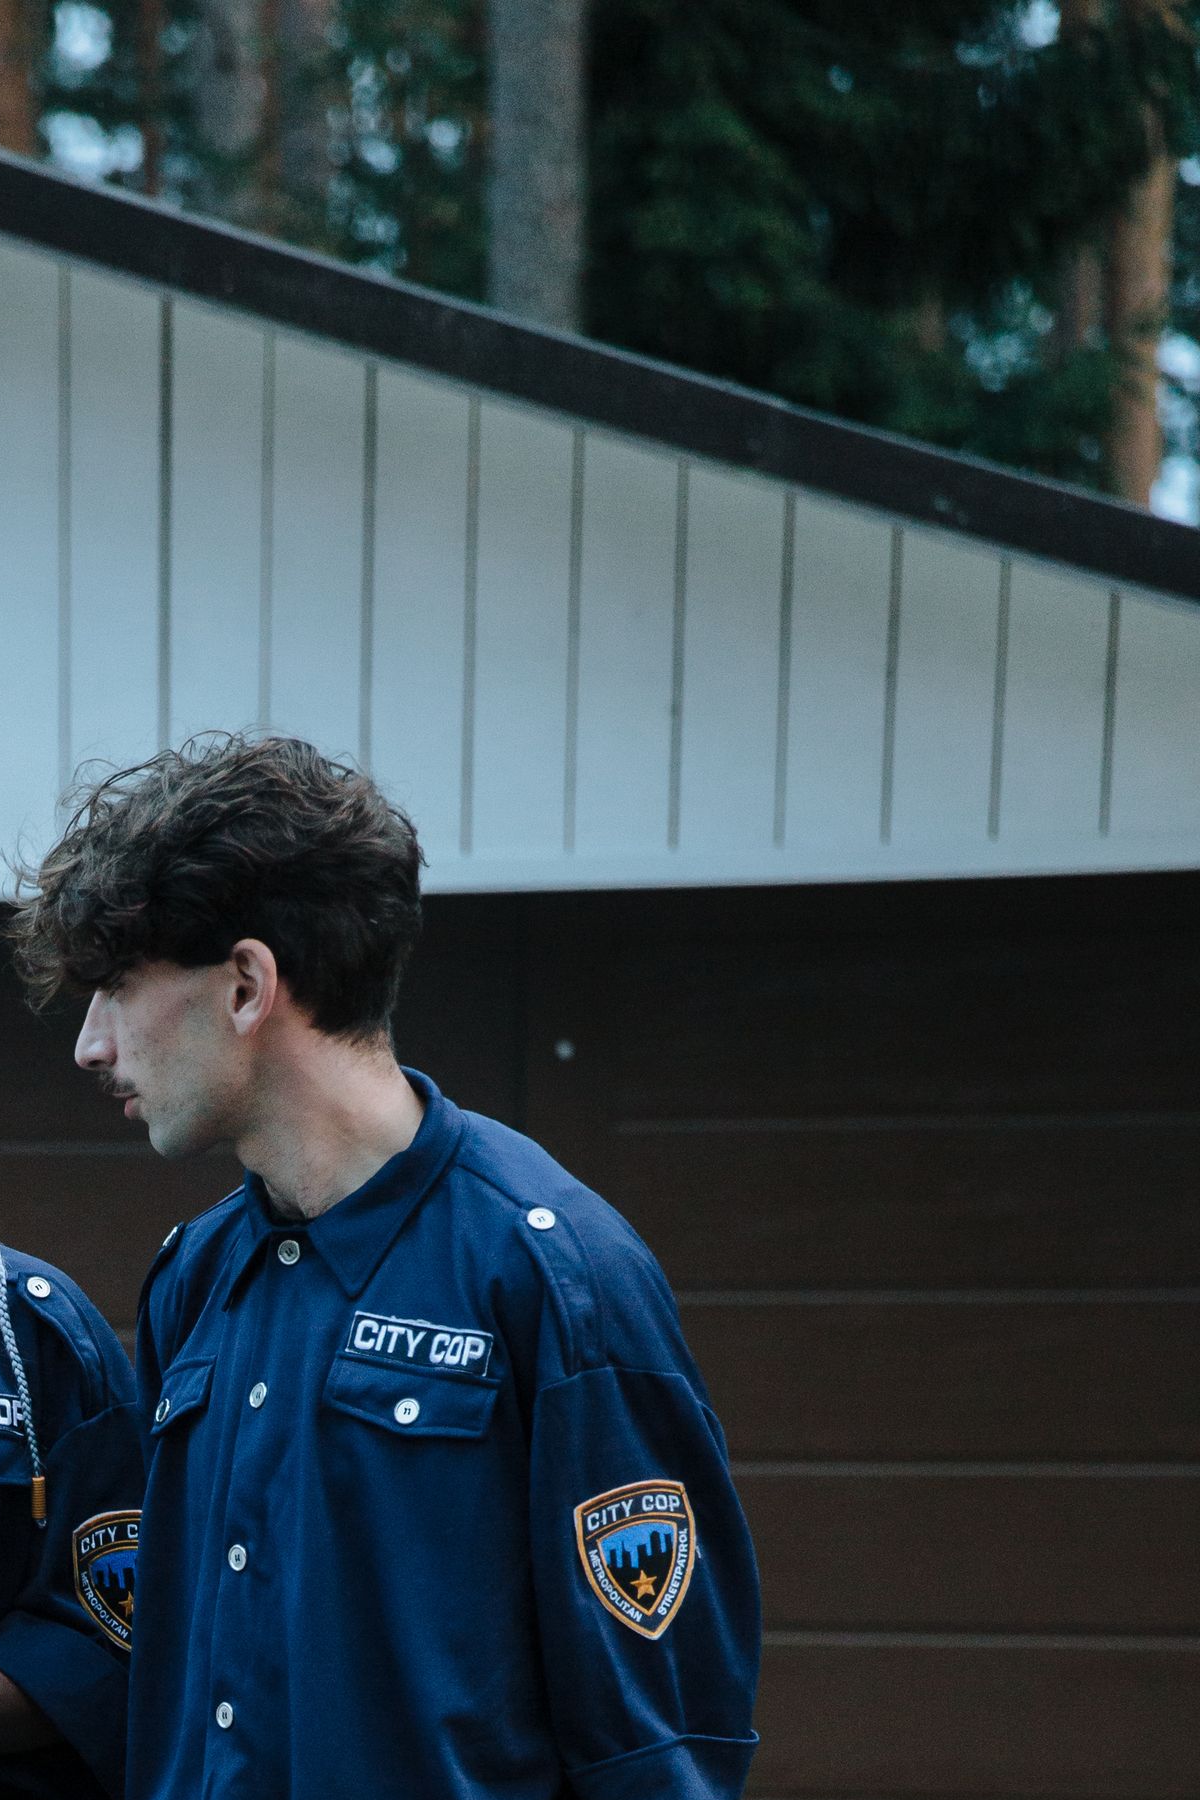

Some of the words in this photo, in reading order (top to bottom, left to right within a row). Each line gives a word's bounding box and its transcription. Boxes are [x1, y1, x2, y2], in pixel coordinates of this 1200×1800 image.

[353, 1319, 427, 1358] CITY
[429, 1332, 486, 1367] COP
[587, 1499, 633, 1532] CITY
[642, 1494, 680, 1512] COP
[81, 1526, 117, 1554] CITY
[588, 1549, 643, 1623] METROPOLITAN
